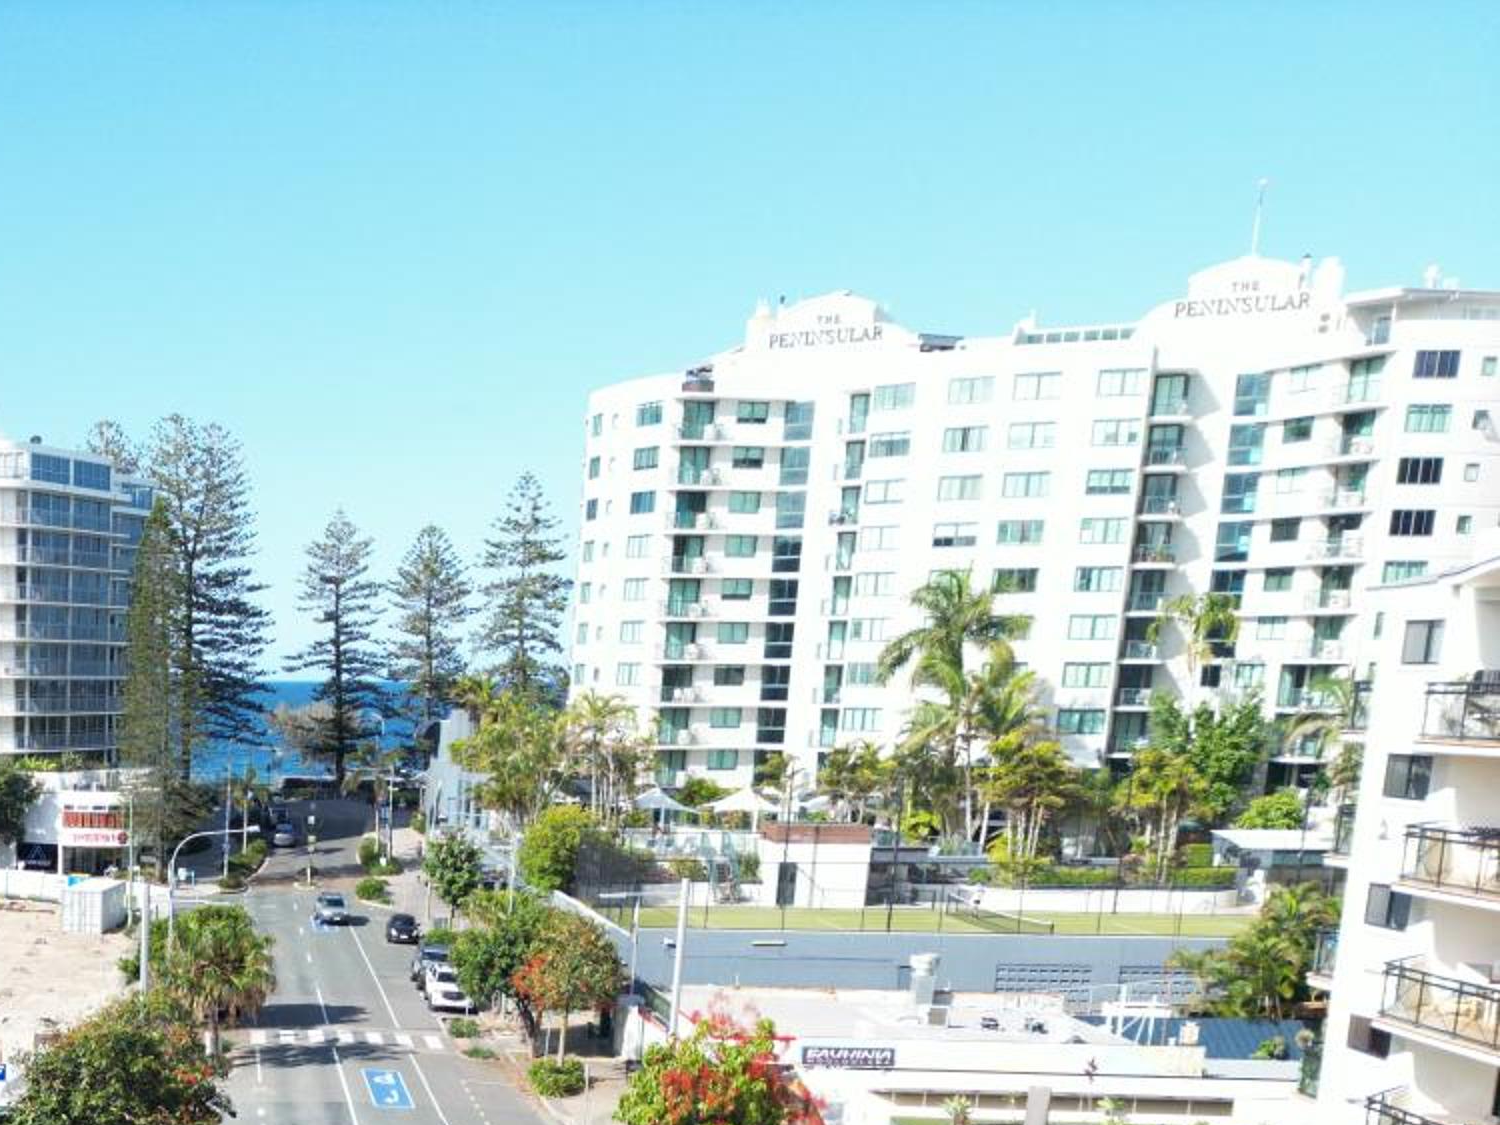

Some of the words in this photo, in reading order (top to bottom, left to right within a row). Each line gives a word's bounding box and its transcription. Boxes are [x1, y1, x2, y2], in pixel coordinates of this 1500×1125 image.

[1232, 281, 1260, 291] THE
[1174, 292, 1310, 318] PENINSULAR
[817, 314, 841, 324] THE
[769, 325, 883, 349] PENINSULAR
